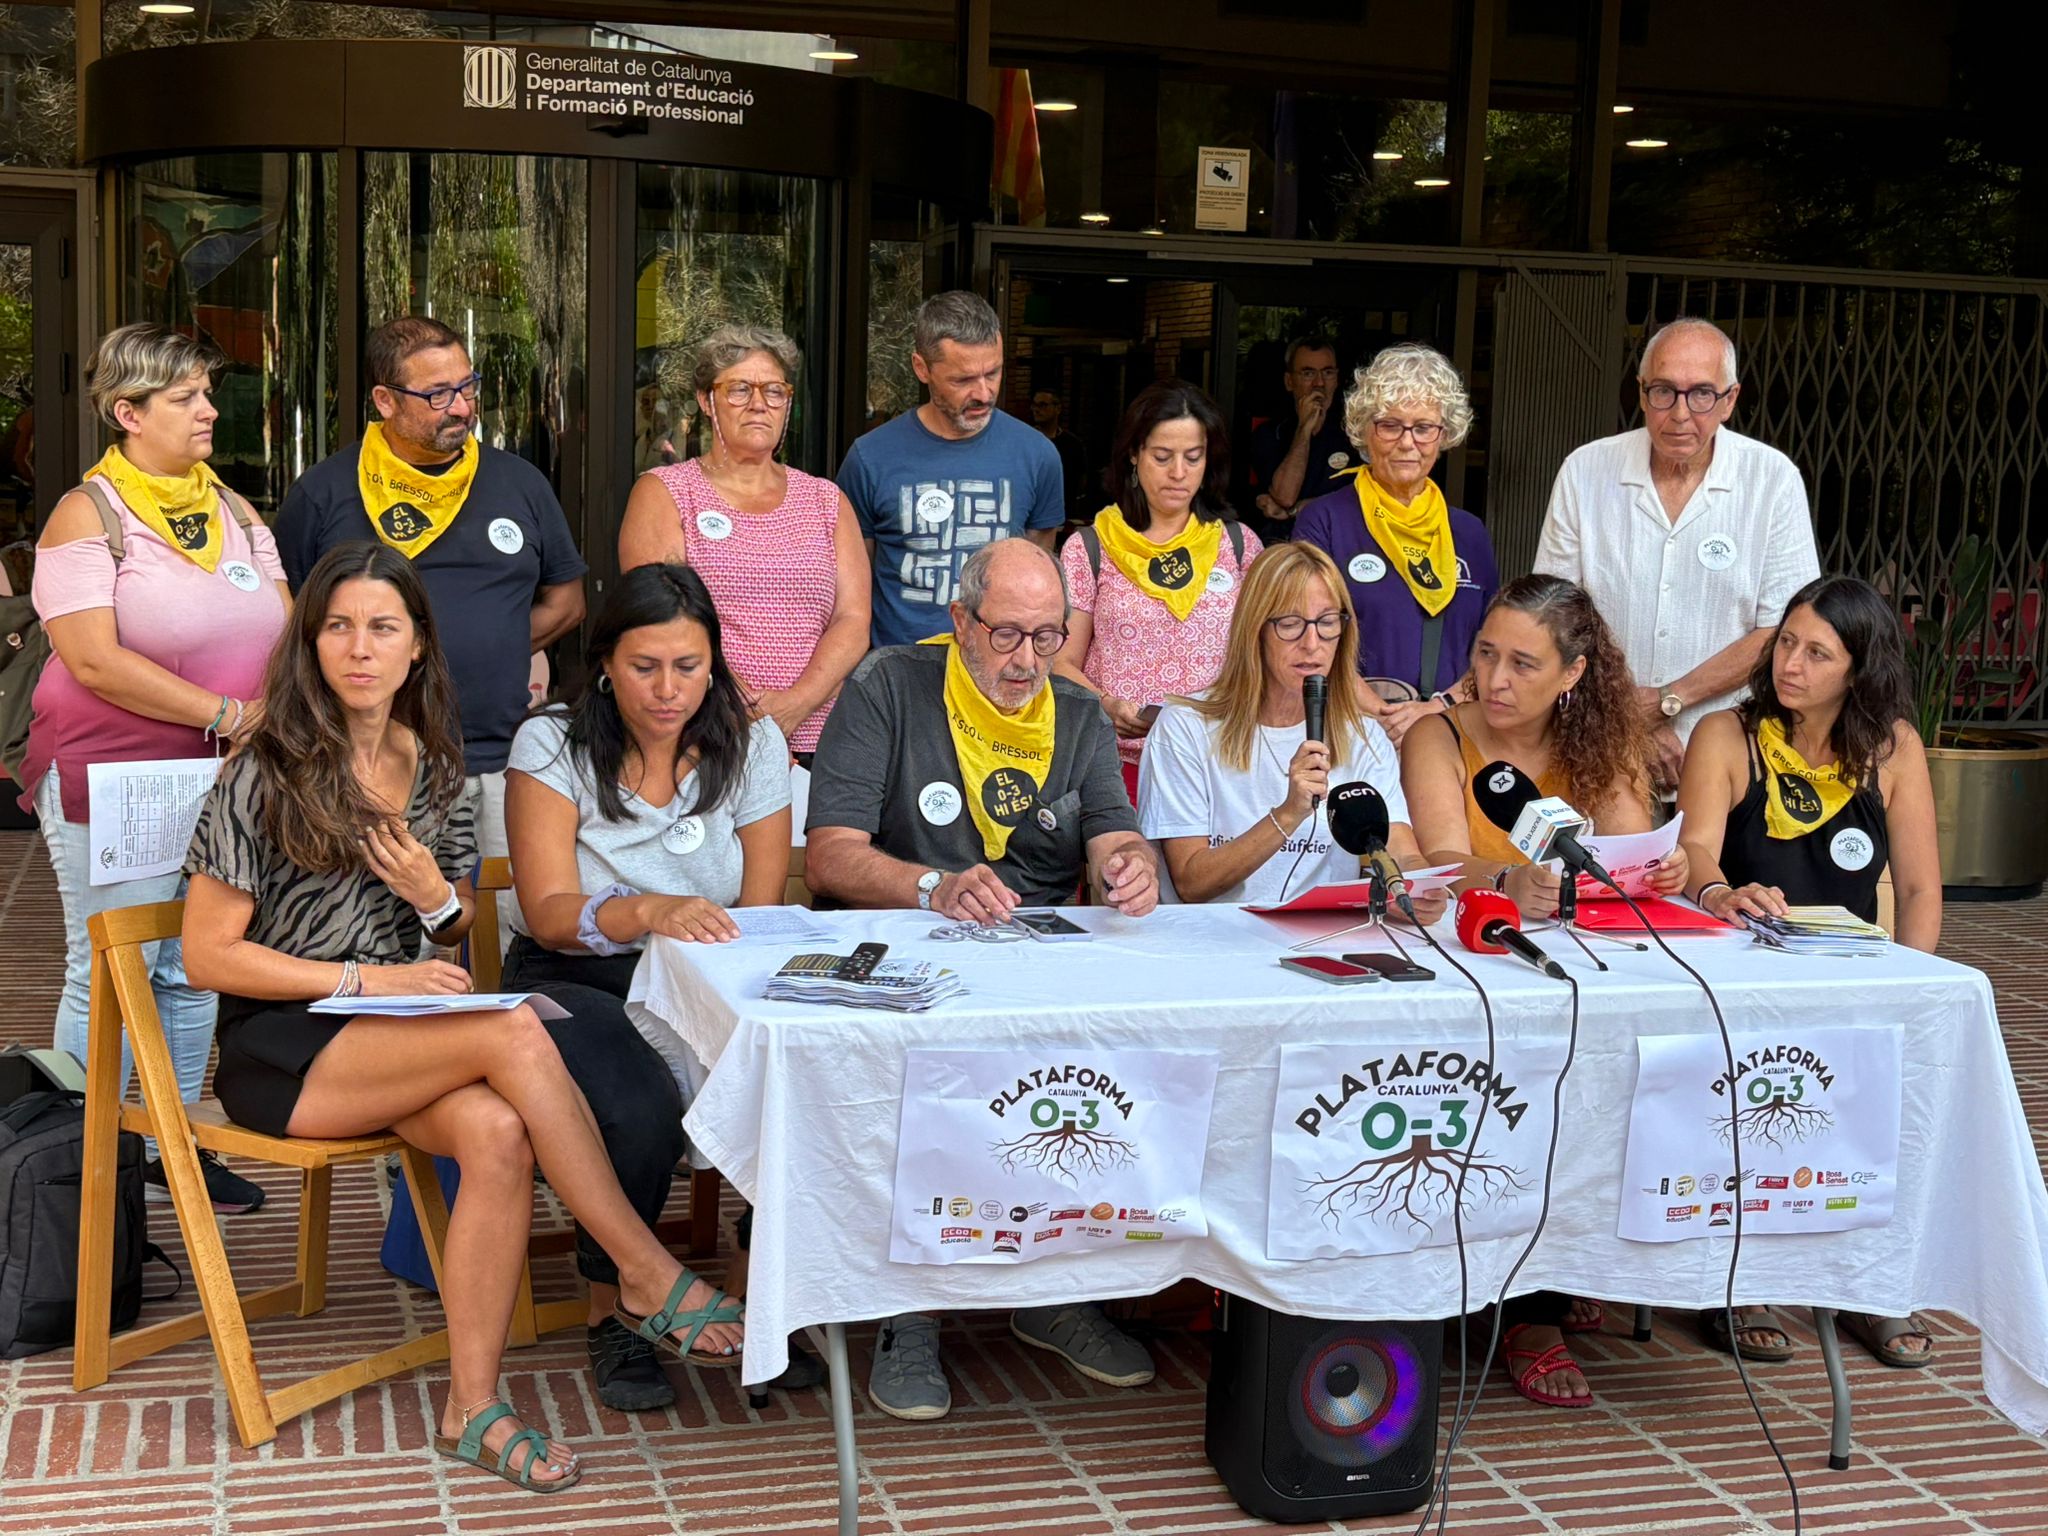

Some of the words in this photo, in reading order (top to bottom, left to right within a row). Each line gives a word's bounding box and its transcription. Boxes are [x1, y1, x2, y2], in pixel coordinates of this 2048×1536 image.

[526, 52, 620, 75] Generalitat
[624, 60, 647, 76] de
[651, 60, 732, 86] Catalunya
[526, 73, 652, 98] Departament
[656, 81, 755, 106] d'Educació
[526, 93, 531, 110] i
[537, 94, 628, 116] Formació
[633, 101, 744, 125] Professional
[390, 479, 435, 504] BRESSOL
[393, 507, 408, 520] EL
[394, 518, 415, 531] 0-3
[1161, 557, 1179, 574] 0-3
[992, 741, 1043, 761] BRESSOL
[995, 772, 1014, 786] EL
[998, 785, 1021, 801] 0-3
[1338, 788, 1376, 800] acn
[994, 803, 1010, 816] HI
[1710, 1045, 1836, 1097] PLATAFORMA
[989, 1065, 1134, 1121] PLATAFORMA
[1047, 1088, 1087, 1098] CATALUNYA
[1295, 1050, 1528, 1137] PLATAFORMA
[1377, 1084, 1459, 1097] CATALUNYA
[1747, 1074, 1805, 1104] 0-3
[1030, 1098, 1100, 1130] 0-3
[1361, 1100, 1469, 1150] 0-3
[1669, 1207, 1691, 1215] CCOO
[942, 1229, 970, 1237] CCOO
